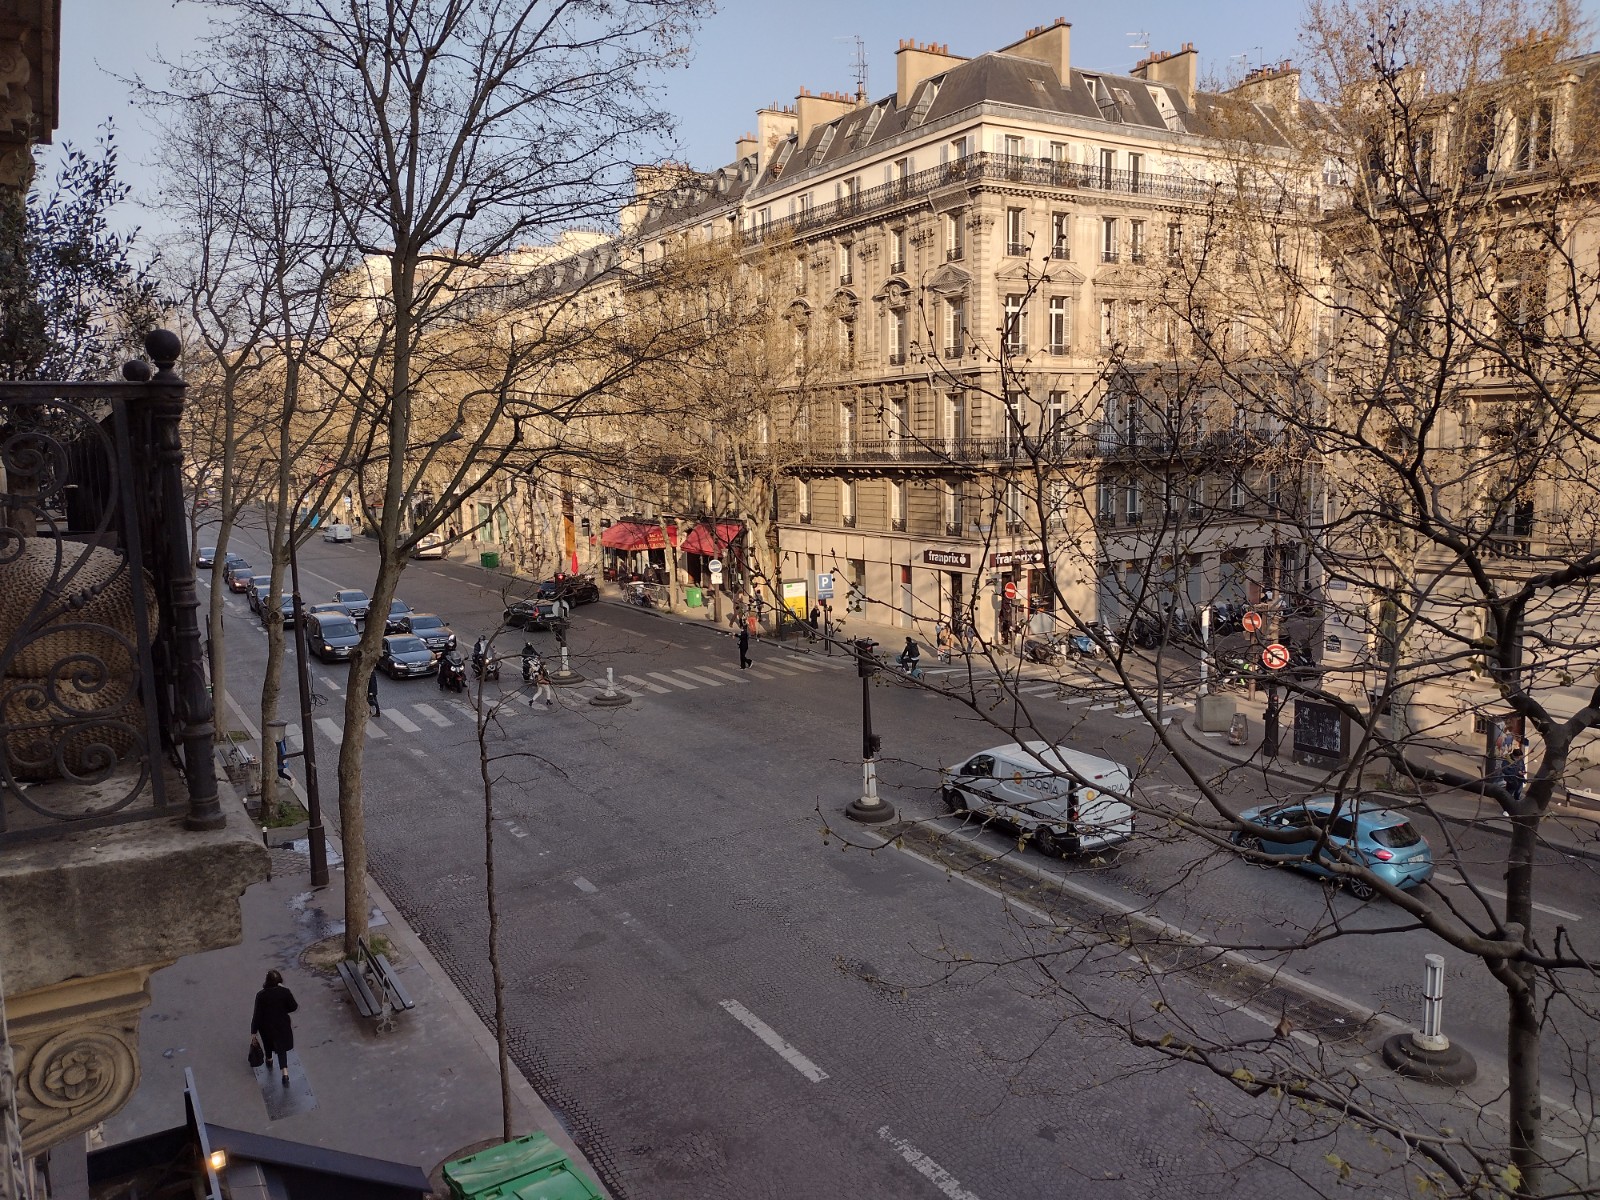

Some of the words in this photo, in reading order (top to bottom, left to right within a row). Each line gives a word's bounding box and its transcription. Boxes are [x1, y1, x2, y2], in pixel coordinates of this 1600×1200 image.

[928, 551, 959, 565] franprix
[995, 553, 1034, 565] fraprix
[821, 576, 829, 588] P
[1026, 779, 1059, 795] ISORIA
